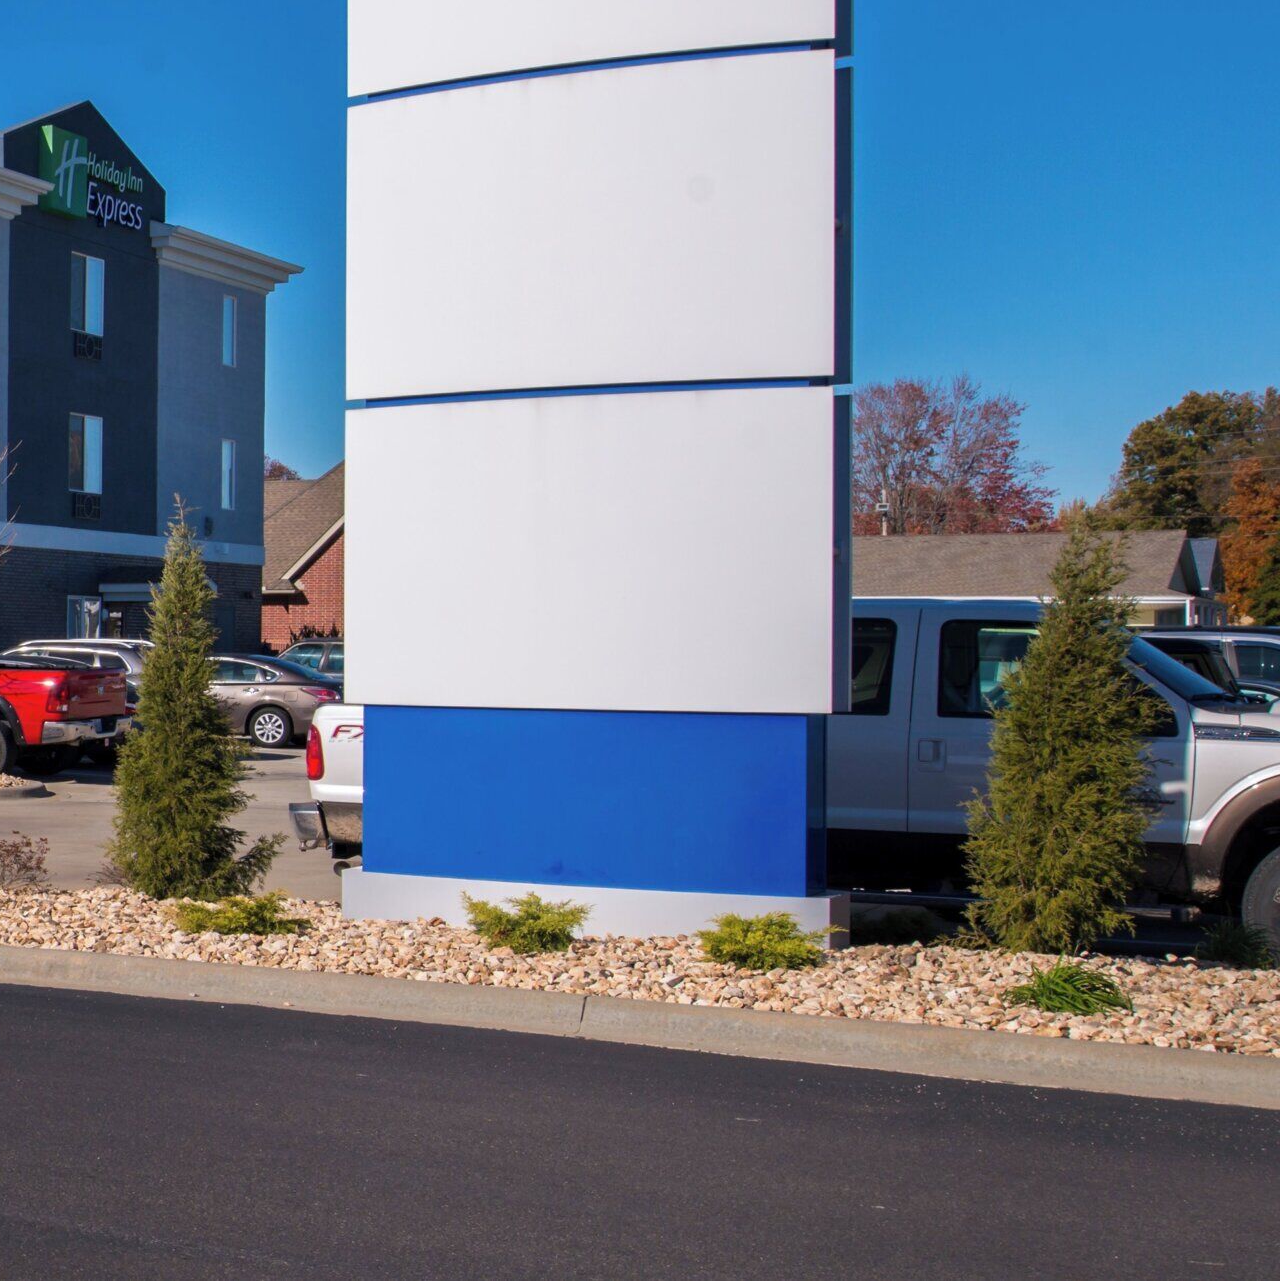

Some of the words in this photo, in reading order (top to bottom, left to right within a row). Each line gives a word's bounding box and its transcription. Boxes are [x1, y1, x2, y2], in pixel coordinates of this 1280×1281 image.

[87, 151, 127, 193] Holiday
[127, 166, 143, 193] Inn
[86, 181, 143, 230] Express
